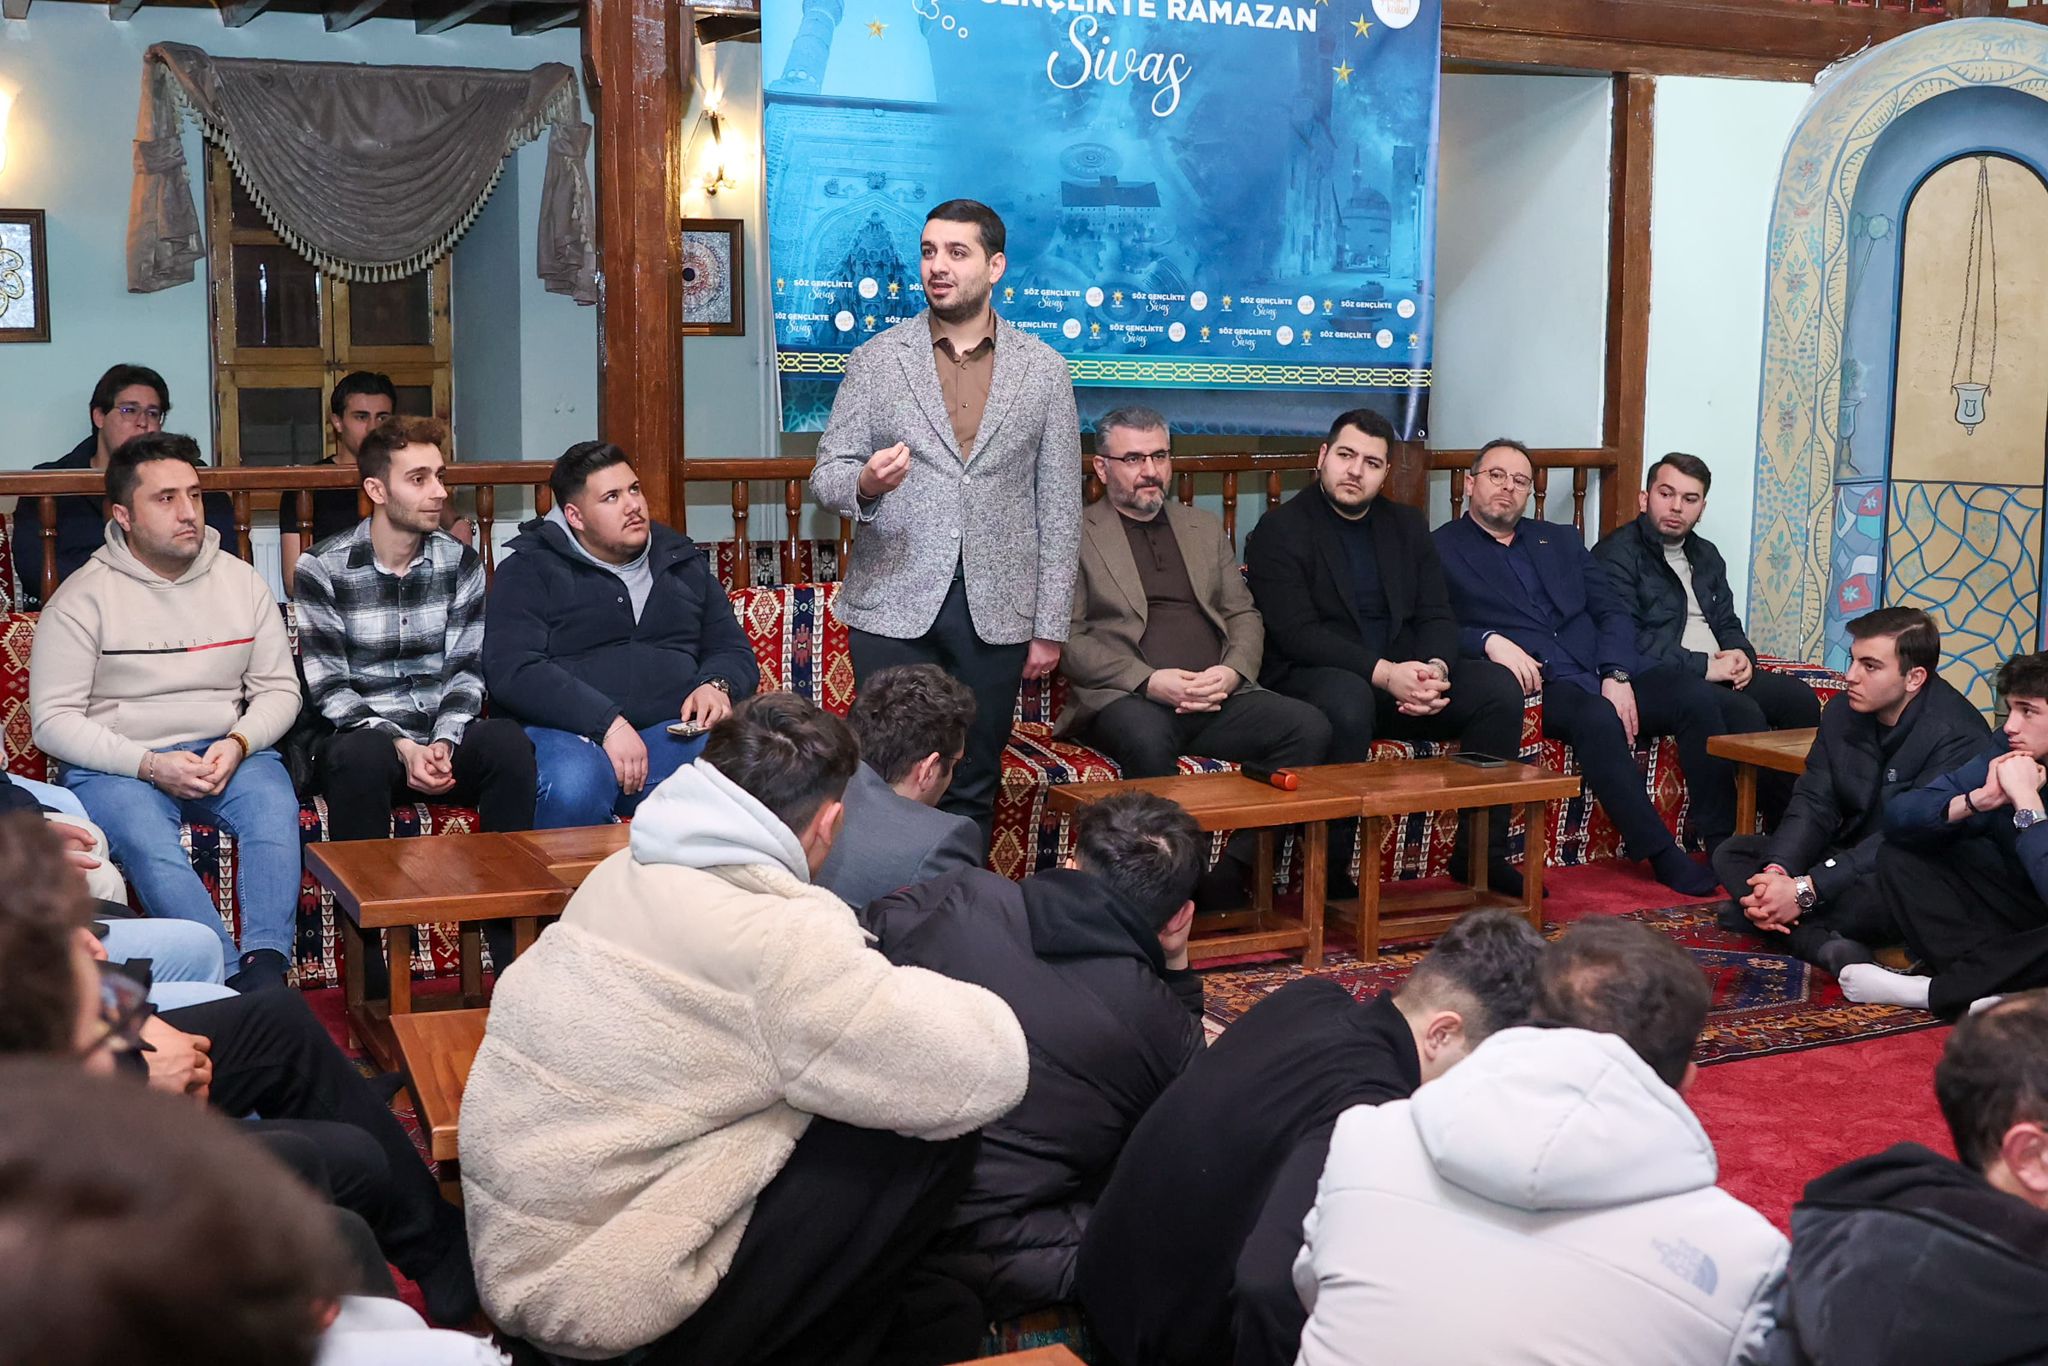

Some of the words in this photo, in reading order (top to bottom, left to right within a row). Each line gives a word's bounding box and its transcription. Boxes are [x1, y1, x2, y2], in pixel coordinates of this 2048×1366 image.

[980, 0, 1156, 18] ÇLKTE
[1167, 0, 1317, 32] RAMAZAN
[1046, 14, 1192, 118] Sivas
[148, 636, 214, 649] PARIS
